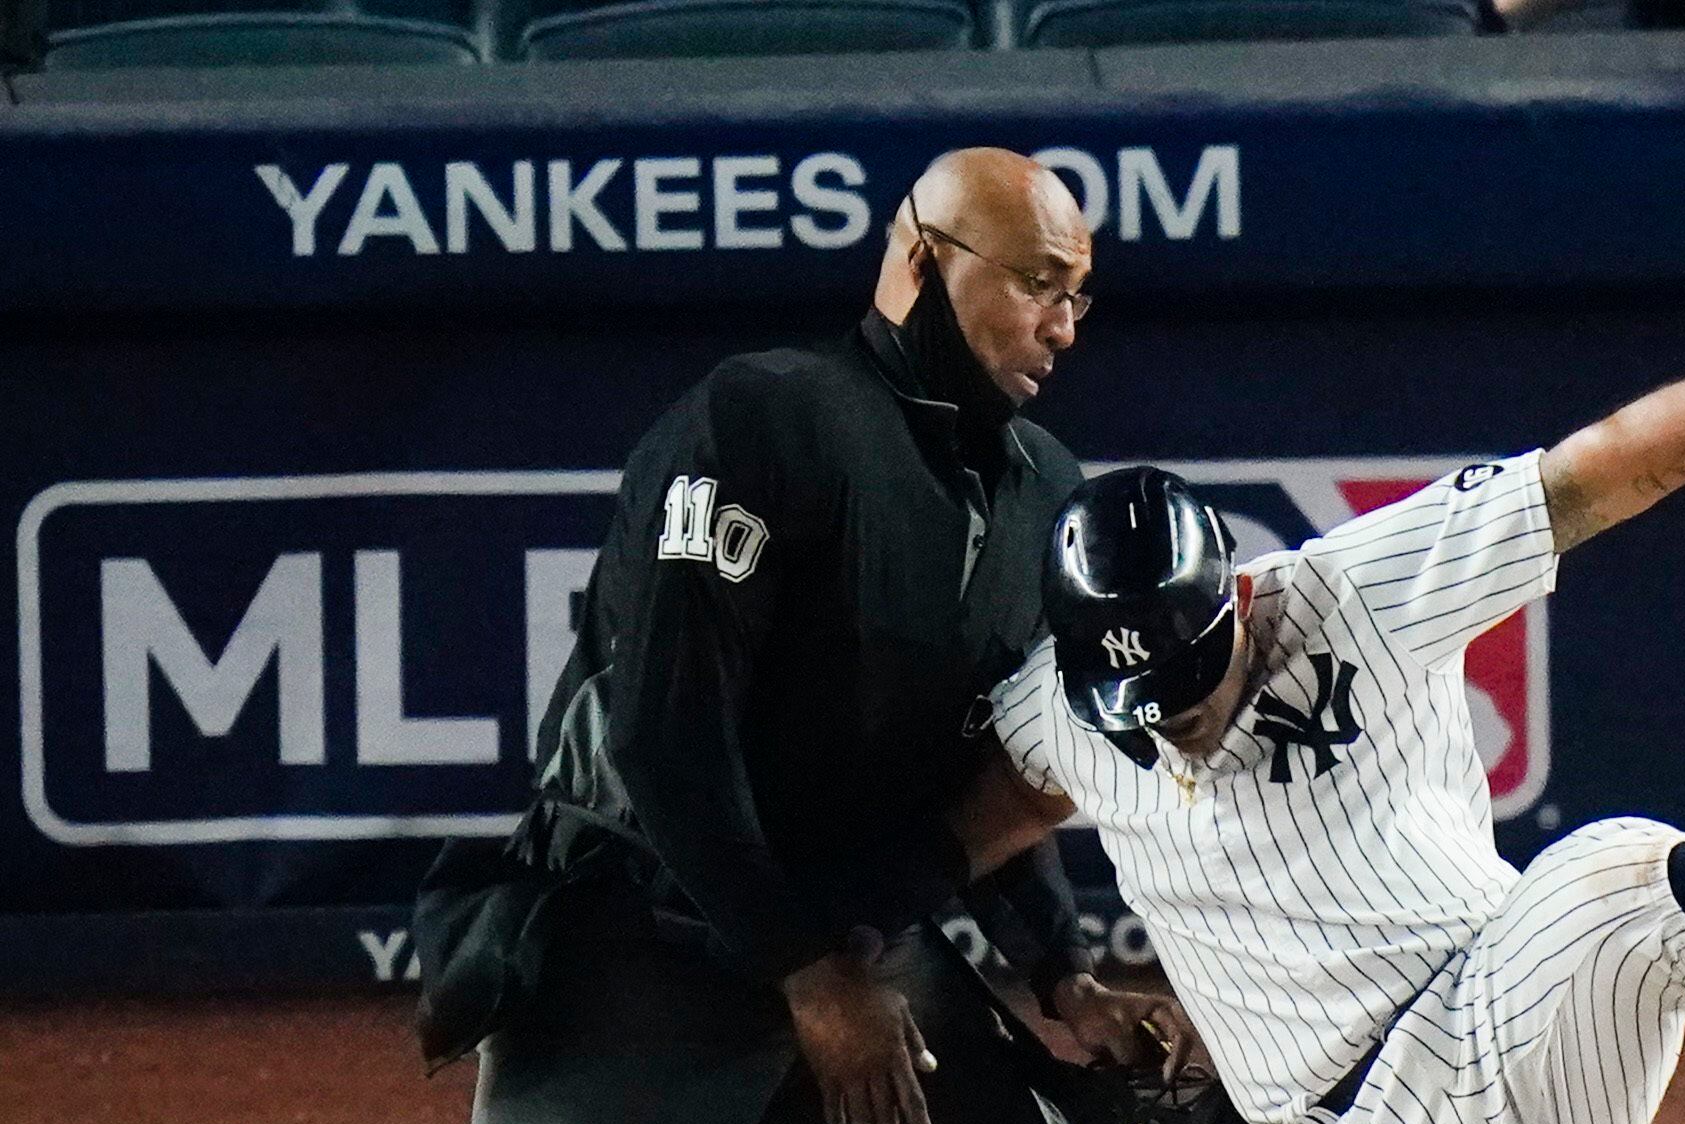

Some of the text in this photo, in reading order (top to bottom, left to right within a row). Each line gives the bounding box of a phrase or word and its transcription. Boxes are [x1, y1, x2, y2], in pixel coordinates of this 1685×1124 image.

[657, 474, 771, 583] 110
[1101, 626, 1151, 670] NY
[1132, 701, 1163, 726] 18
[1251, 651, 1366, 785] NY
